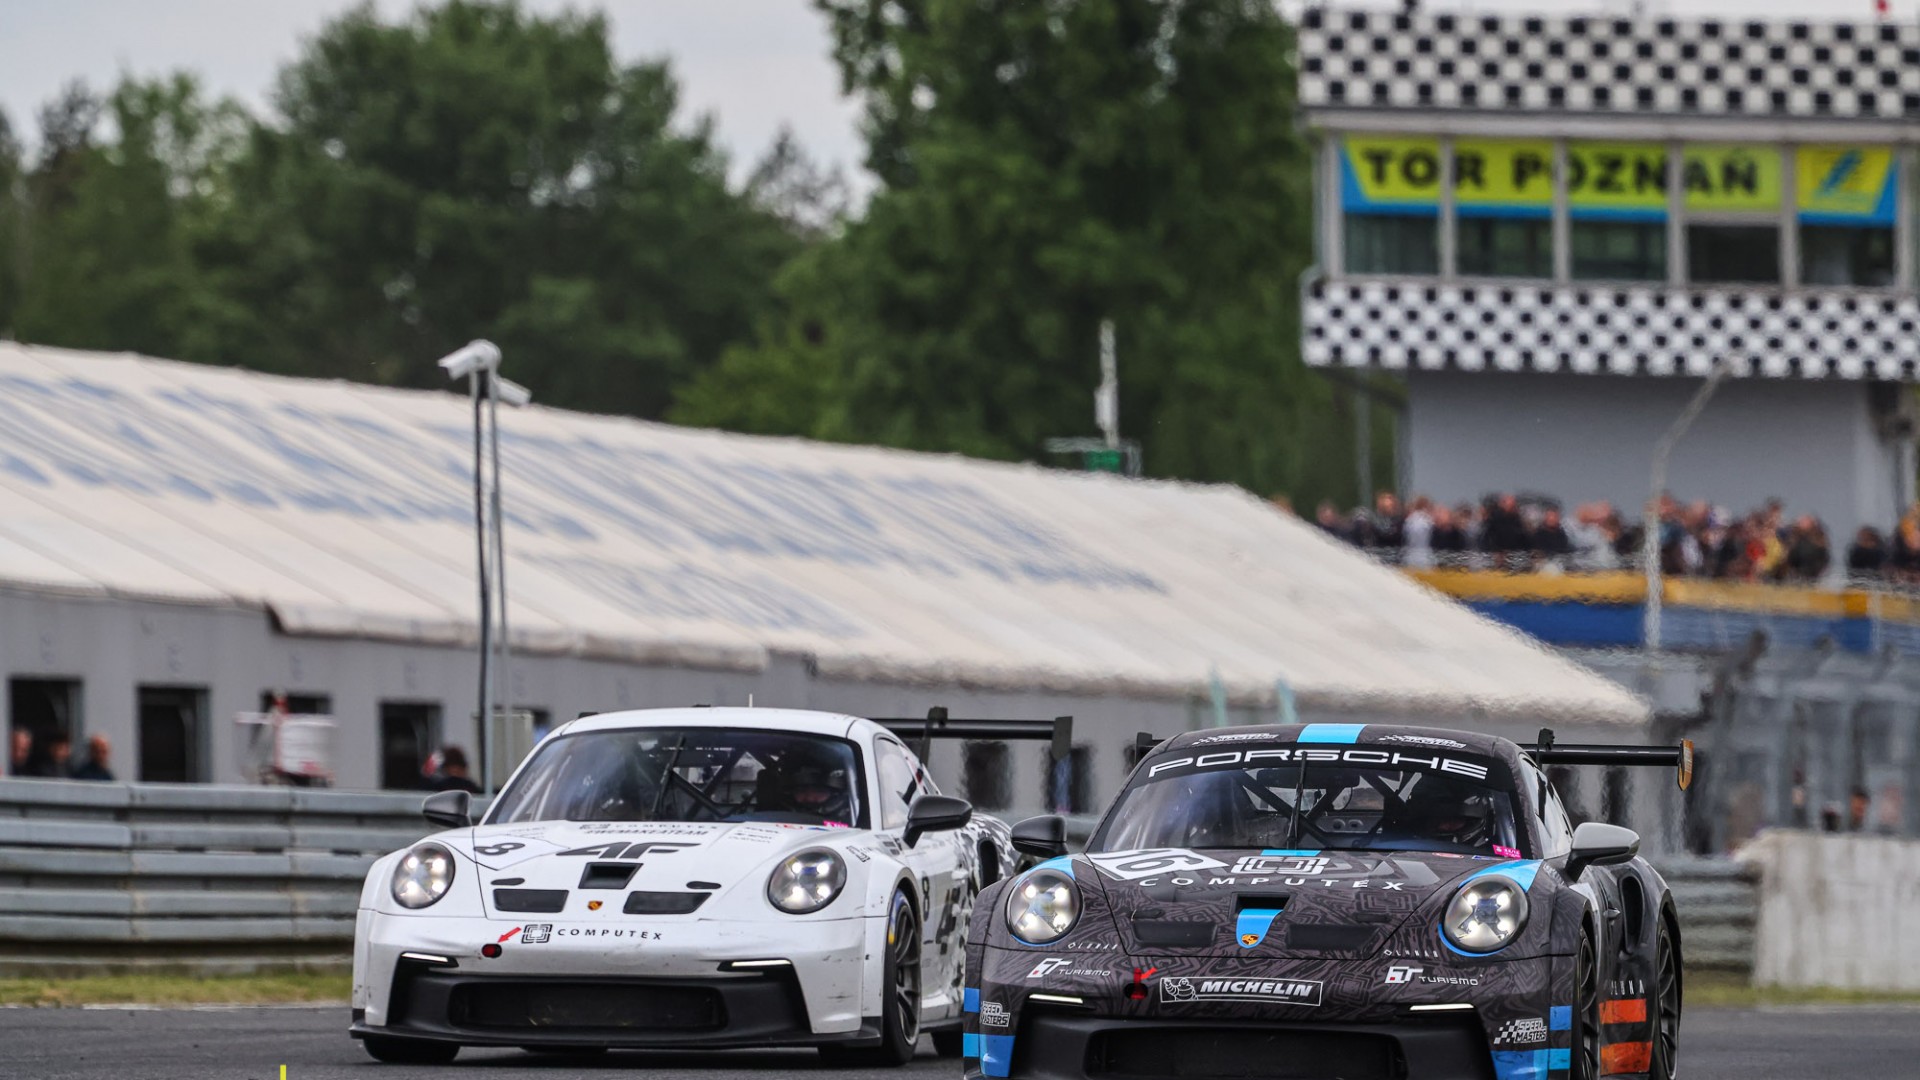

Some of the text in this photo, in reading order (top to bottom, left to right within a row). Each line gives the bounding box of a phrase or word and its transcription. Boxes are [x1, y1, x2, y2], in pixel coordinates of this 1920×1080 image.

[1363, 147, 1758, 197] TOR POZNAŃ
[1148, 749, 1488, 780] PORSCHE
[473, 842, 525, 856] 8
[1138, 877, 1406, 891] COMPUTEX
[921, 875, 931, 922] 8
[557, 928, 663, 940] COMPUTEX
[1058, 968, 1111, 977] TURISMO
[1418, 976, 1479, 986] TURISMO
[1199, 980, 1313, 997] MICHELIN
[1517, 1020, 1543, 1031] SPEED
[1515, 1029, 1547, 1041] MASTERS
